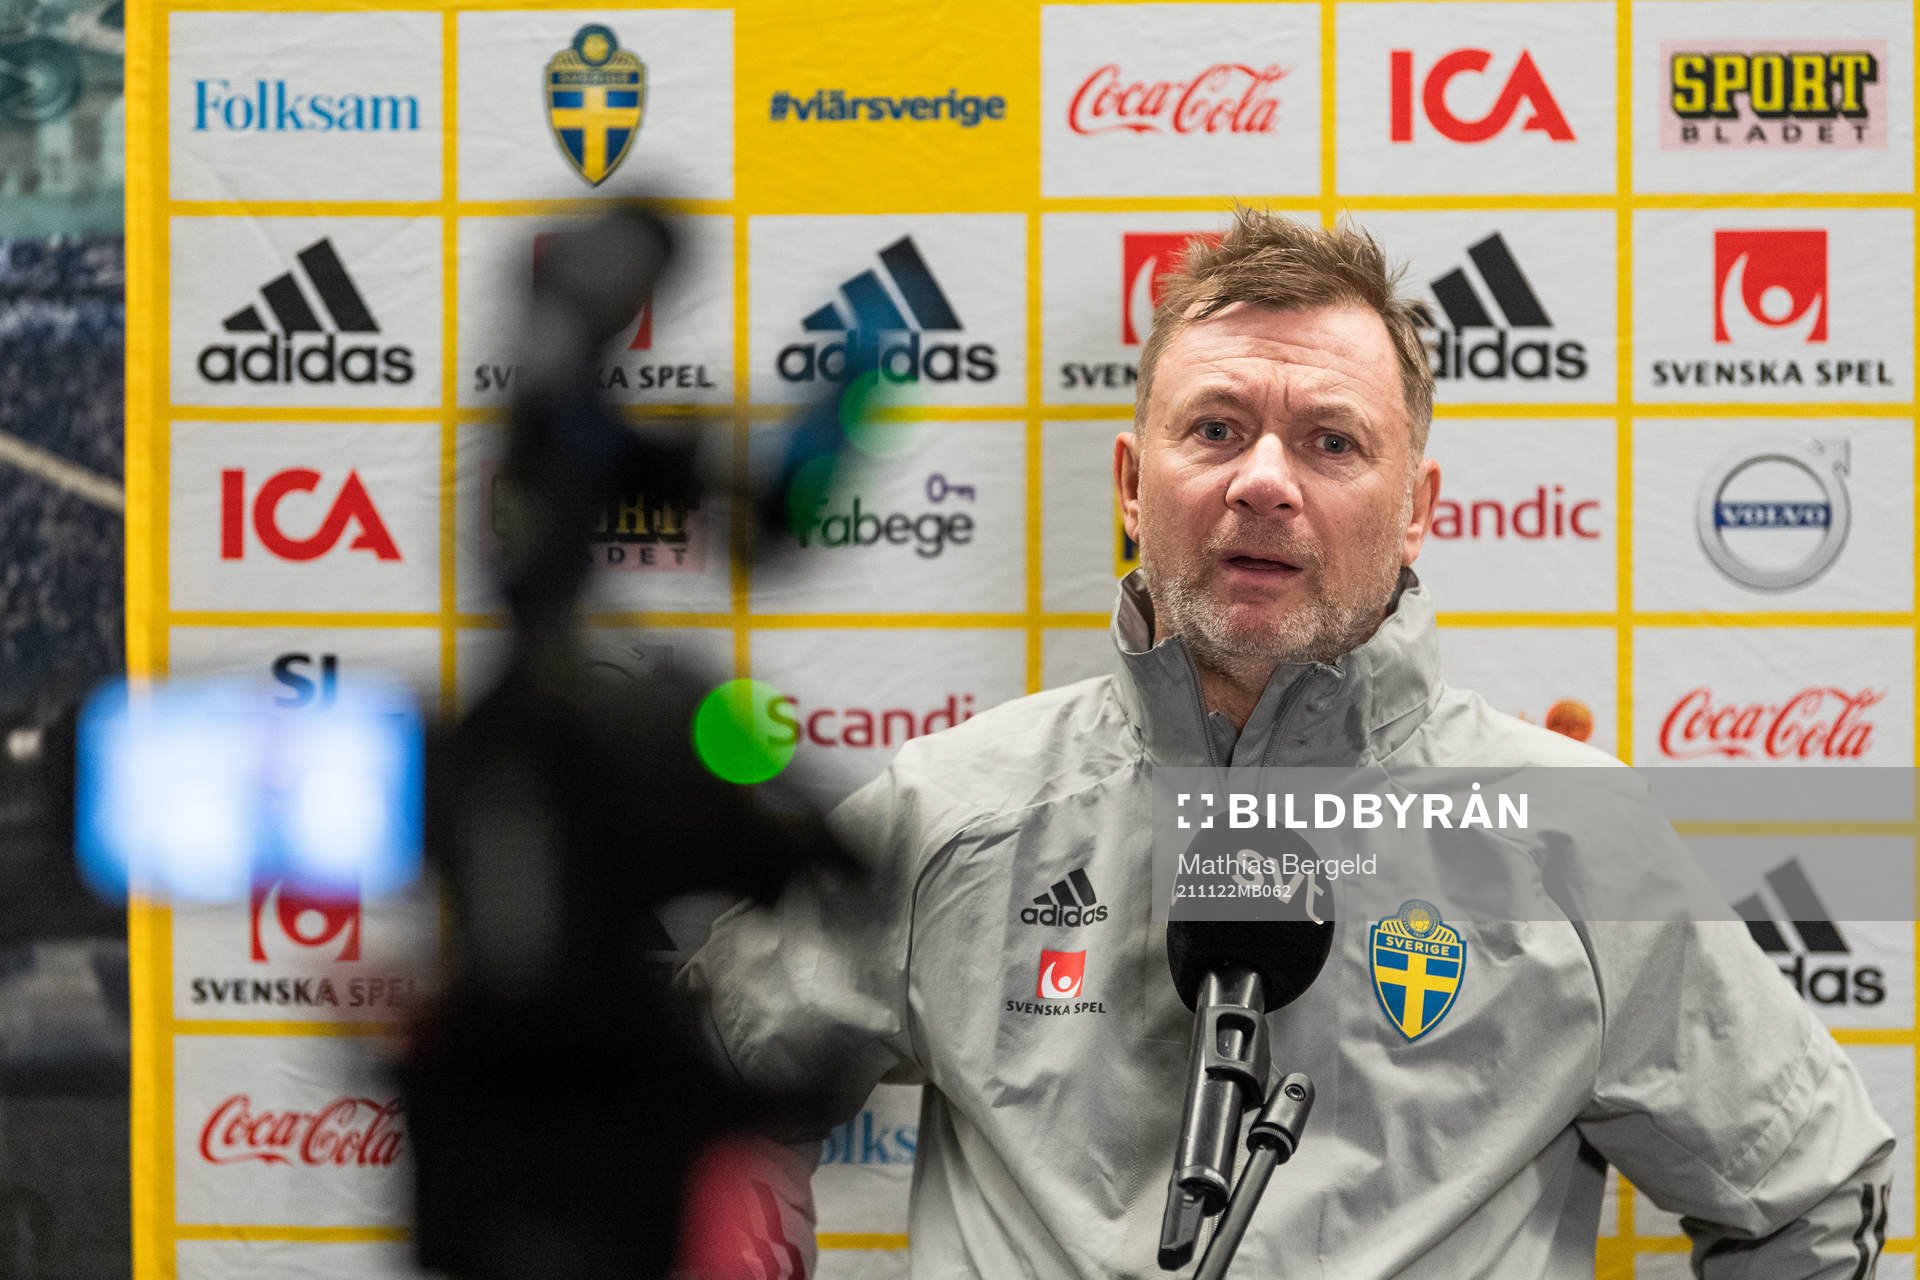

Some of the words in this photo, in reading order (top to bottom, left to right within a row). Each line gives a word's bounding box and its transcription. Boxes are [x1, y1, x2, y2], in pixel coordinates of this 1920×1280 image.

[1067, 62, 1293, 137] Coca-Cola
[1390, 48, 1577, 143] ICA
[1670, 50, 1878, 119] SPORT
[192, 78, 421, 134] Folksam
[769, 87, 1006, 127] #viärsverige
[1681, 122, 1868, 144] BLADET
[198, 332, 415, 386] adidas
[638, 364, 717, 390] SPEL
[1652, 359, 1804, 388] SVENSKA
[1815, 359, 1894, 388] SPEL
[220, 466, 404, 563] ICA
[1431, 484, 1602, 540] andic
[1722, 503, 1827, 527] VOLVO
[1659, 686, 1890, 761] Coca-Cola
[1020, 904, 1109, 927] adidas
[1385, 936, 1450, 956] SVERIGE
[191, 977, 339, 1008] SVENSKA
[1006, 1001, 1070, 1016] SVENSKA
[1074, 1002, 1106, 1015] SPEL
